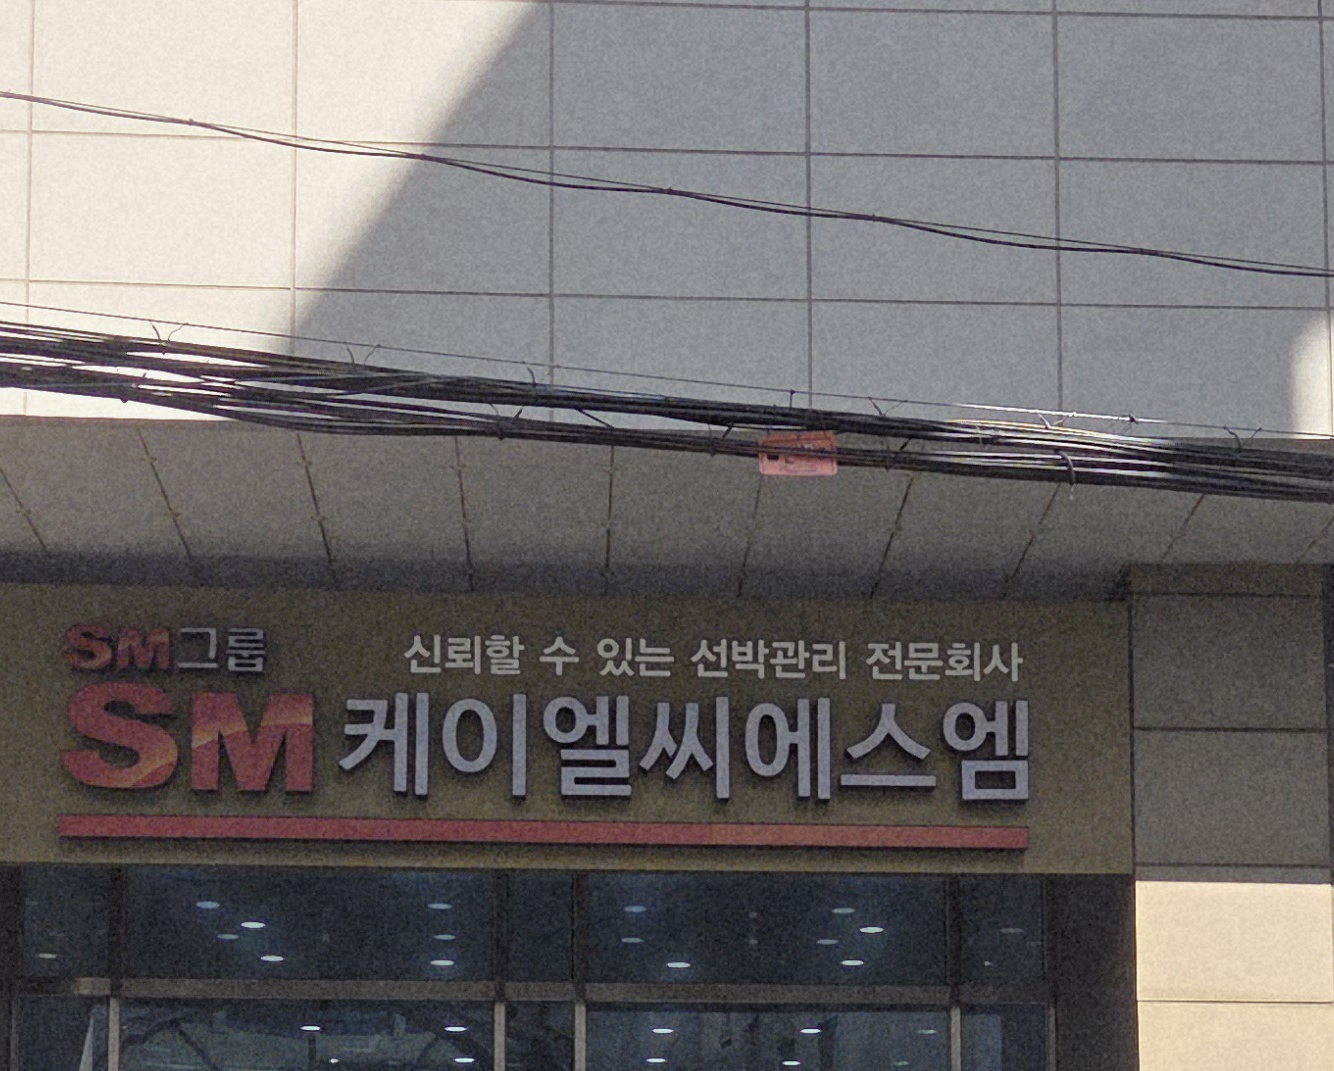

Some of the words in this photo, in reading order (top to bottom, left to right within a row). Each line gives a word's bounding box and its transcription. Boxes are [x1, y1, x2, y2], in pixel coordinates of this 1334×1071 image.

[403, 633, 526, 677] 신뢰할
[539, 634, 580, 677] 수
[596, 635, 675, 678] 있는
[689, 637, 847, 680] 선박관리
[865, 641, 1023, 682] 전문회사
[60, 680, 316, 793] SM
[337, 690, 1032, 800] 케이엘씨에스엠
